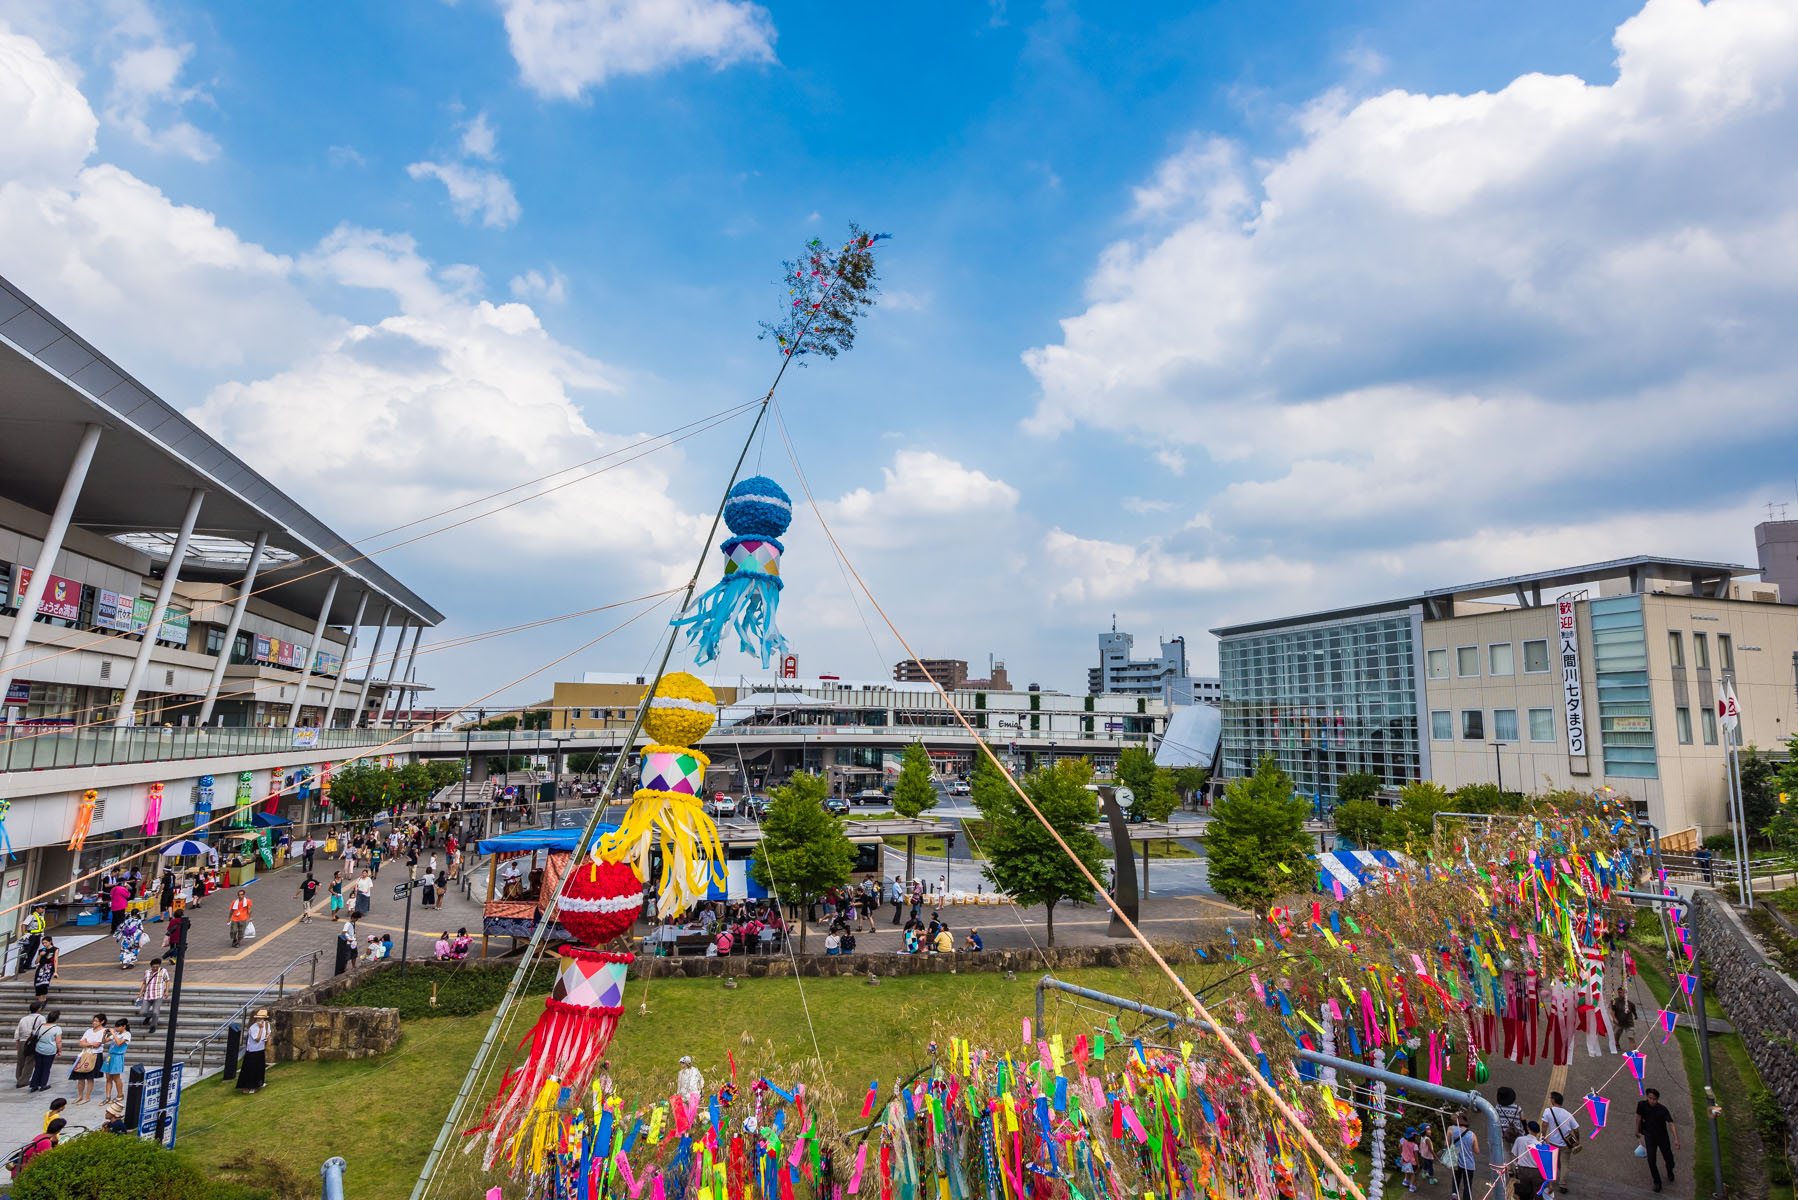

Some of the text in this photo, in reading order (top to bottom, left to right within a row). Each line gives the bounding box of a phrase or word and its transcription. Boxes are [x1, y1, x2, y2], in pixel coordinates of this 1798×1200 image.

[1559, 601, 1573, 629] 歓迎
[1562, 640, 1582, 752] 入間川七夕まつり
